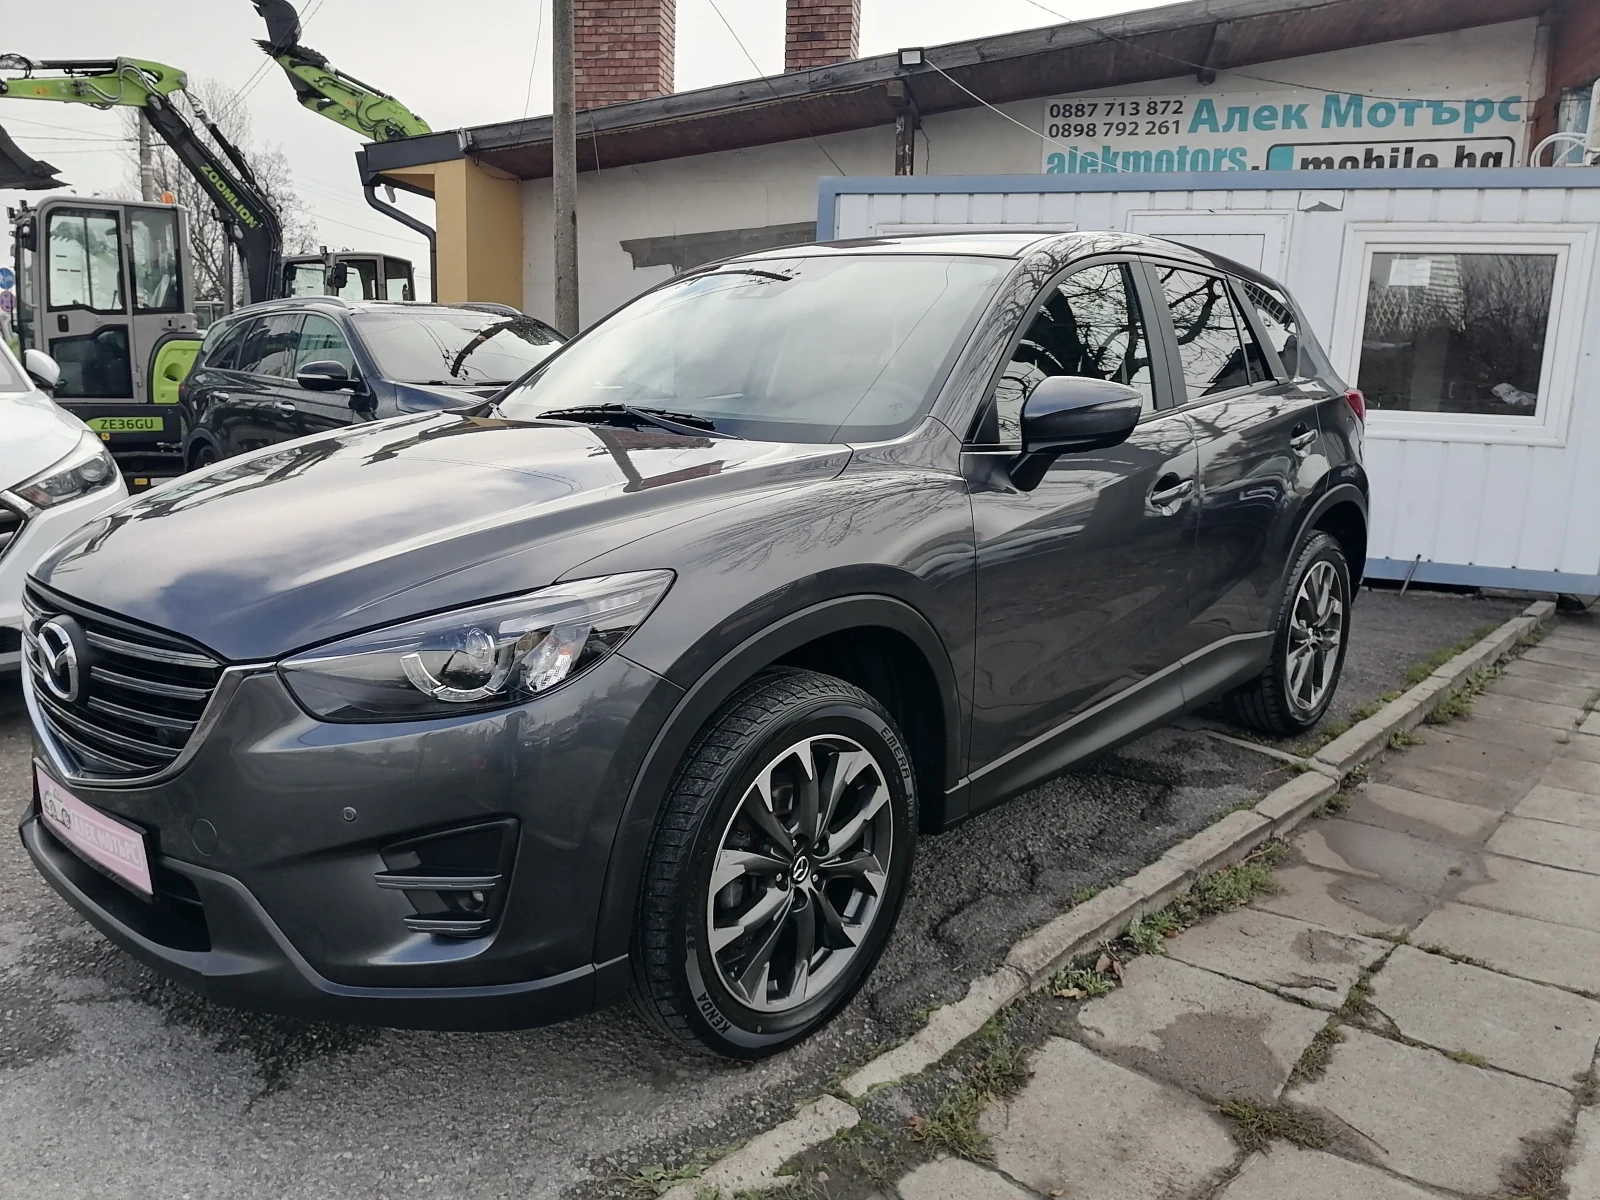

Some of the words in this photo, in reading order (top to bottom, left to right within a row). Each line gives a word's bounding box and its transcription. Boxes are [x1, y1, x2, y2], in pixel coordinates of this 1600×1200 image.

[1048, 122, 1097, 138] 0898
[1103, 121, 1140, 137] 792
[1144, 119, 1181, 136] 261
[1049, 103, 1099, 119] 0887
[1104, 101, 1140, 117] 713
[1146, 99, 1184, 116] 872
[1187, 98, 1310, 134] Алек
[1321, 93, 1522, 134] Мотърс
[200, 162, 258, 229] ZOOMLION
[100, 418, 154, 430] ZE36GU
[880, 726, 912, 780] EMERA
[696, 991, 732, 1034] KENDA
